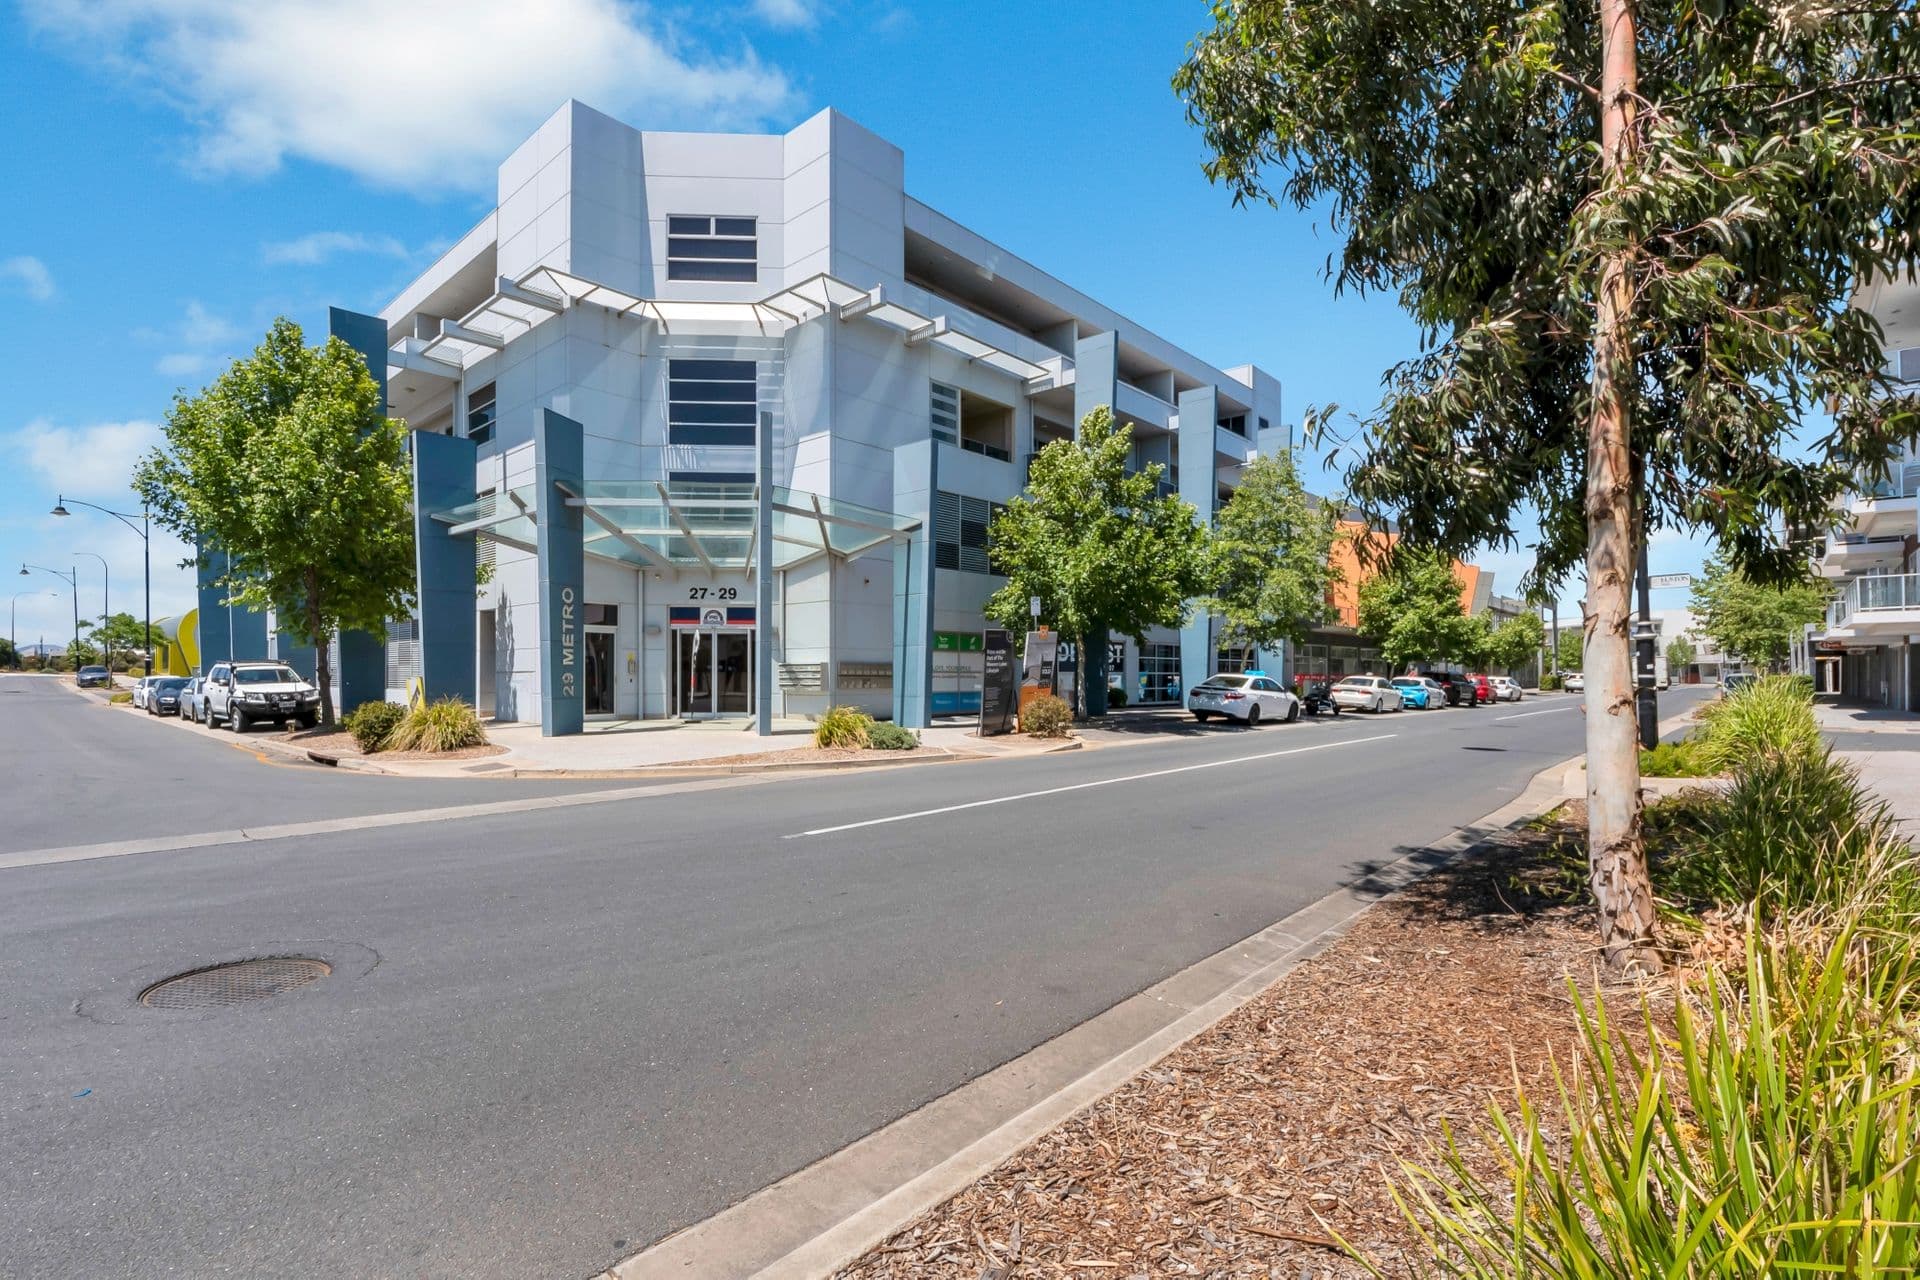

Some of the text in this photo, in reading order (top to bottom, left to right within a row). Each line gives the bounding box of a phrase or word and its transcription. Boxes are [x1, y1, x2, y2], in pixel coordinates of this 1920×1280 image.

[689, 587, 708, 600] 27
[718, 587, 737, 600] 29
[562, 587, 575, 697] 29 METRO
